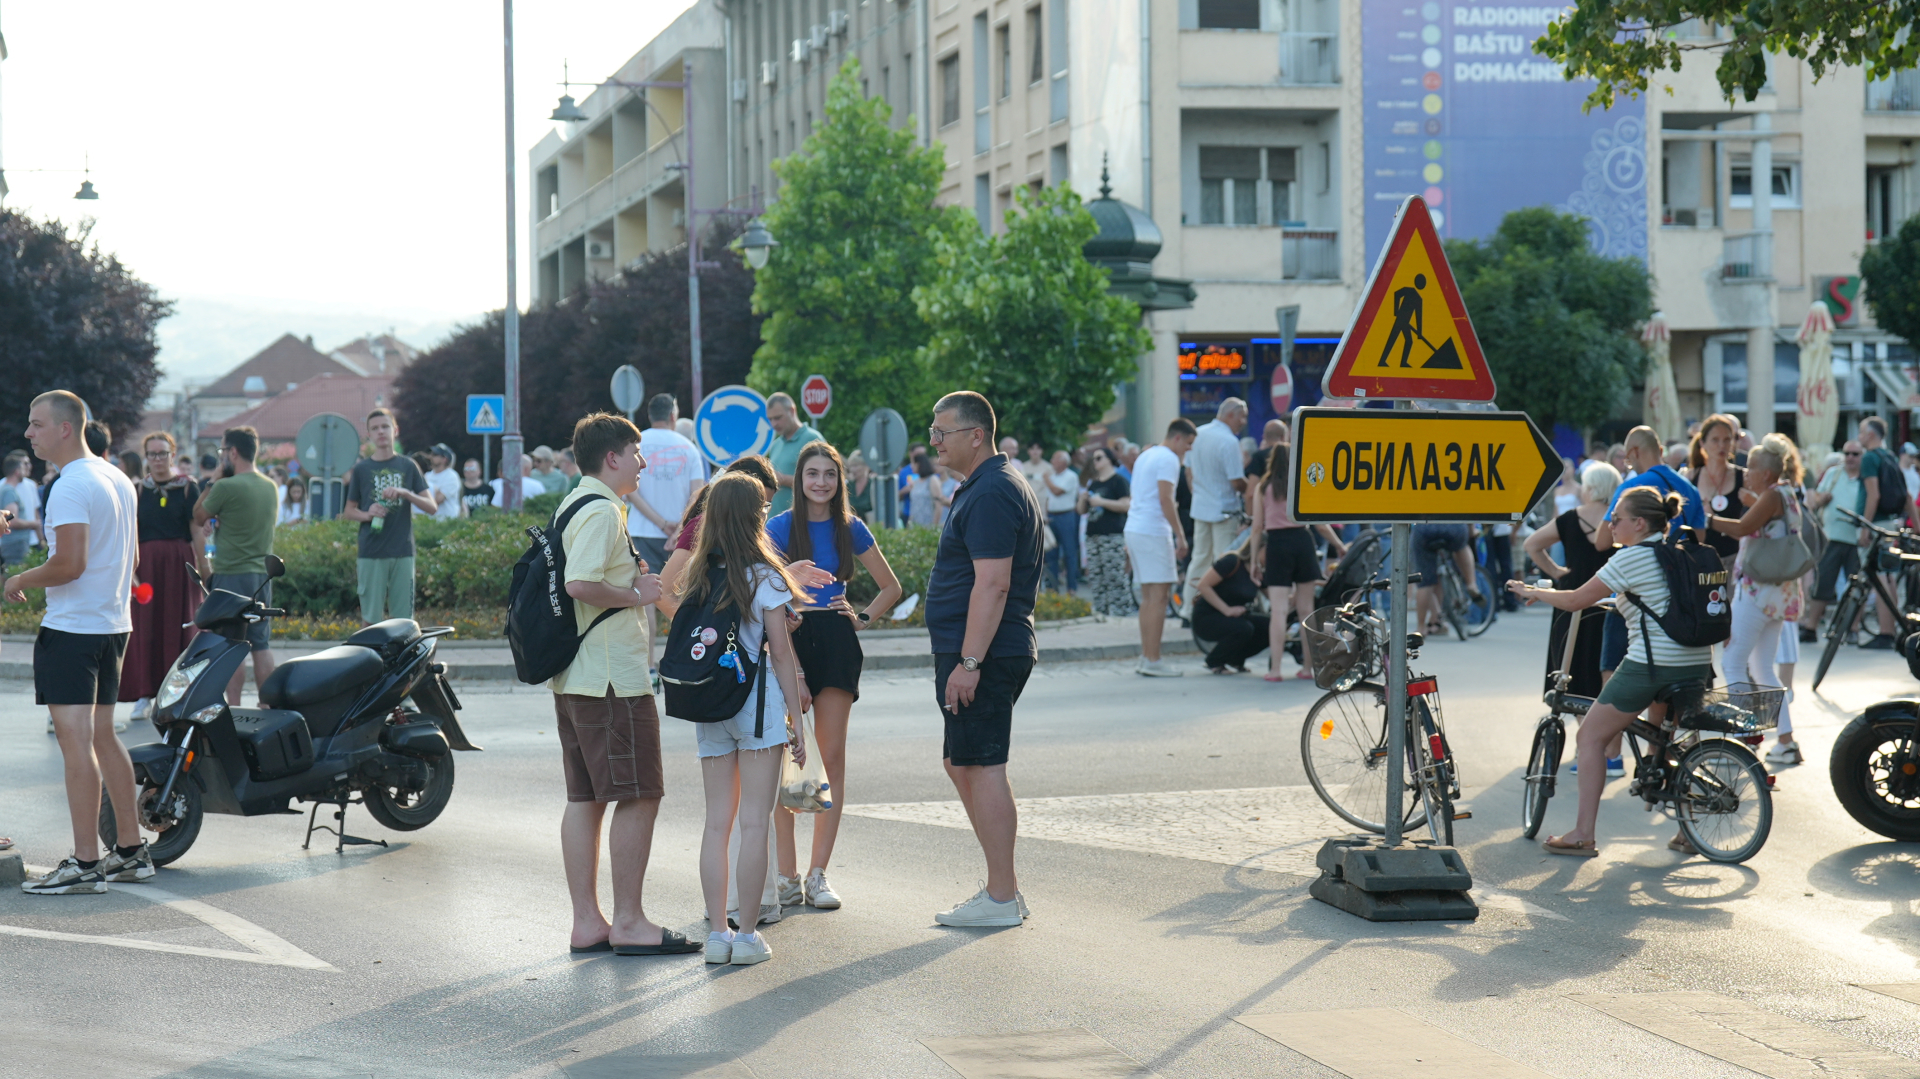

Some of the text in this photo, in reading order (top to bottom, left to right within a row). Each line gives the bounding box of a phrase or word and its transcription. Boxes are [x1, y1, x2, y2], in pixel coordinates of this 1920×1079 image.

[1454, 31, 1523, 53] BAŠTU
[805, 389, 827, 404] STOP
[1332, 441, 1506, 491] ОБИЛАЗАК
